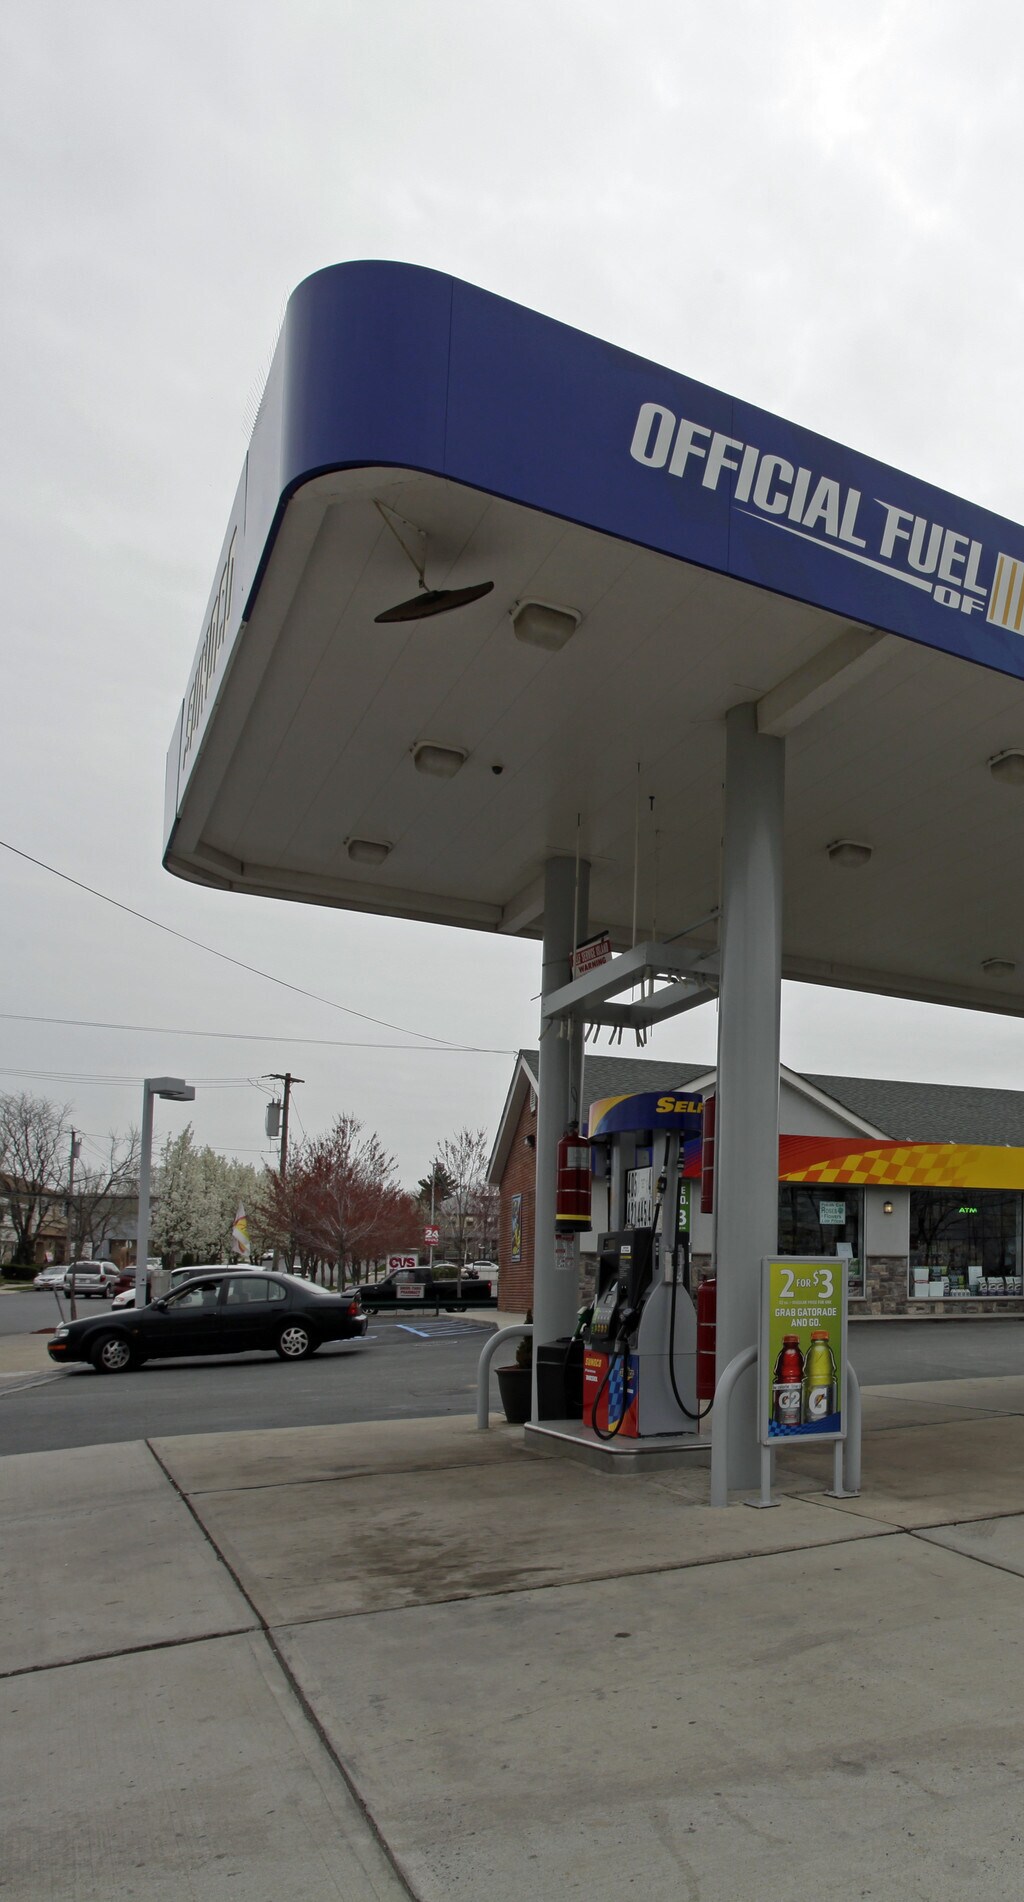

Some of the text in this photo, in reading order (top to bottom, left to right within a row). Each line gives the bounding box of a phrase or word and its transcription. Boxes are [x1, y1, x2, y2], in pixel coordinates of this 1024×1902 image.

[630, 402, 988, 597] OFFICIAL FUEL
[932, 584, 986, 615] OF
[579, 957, 607, 973] WARNING
[958, 1206, 978, 1214] ATM
[424, 1229, 439, 1238] 24
[389, 1258, 416, 1268] CVS
[779, 1269, 834, 1299] 2 FOR $3
[775, 1308, 837, 1317] GRAB GATORADE
[791, 1318, 822, 1327] AND GO.
[778, 1390, 800, 1409] G2
[808, 1387, 828, 1415] G
